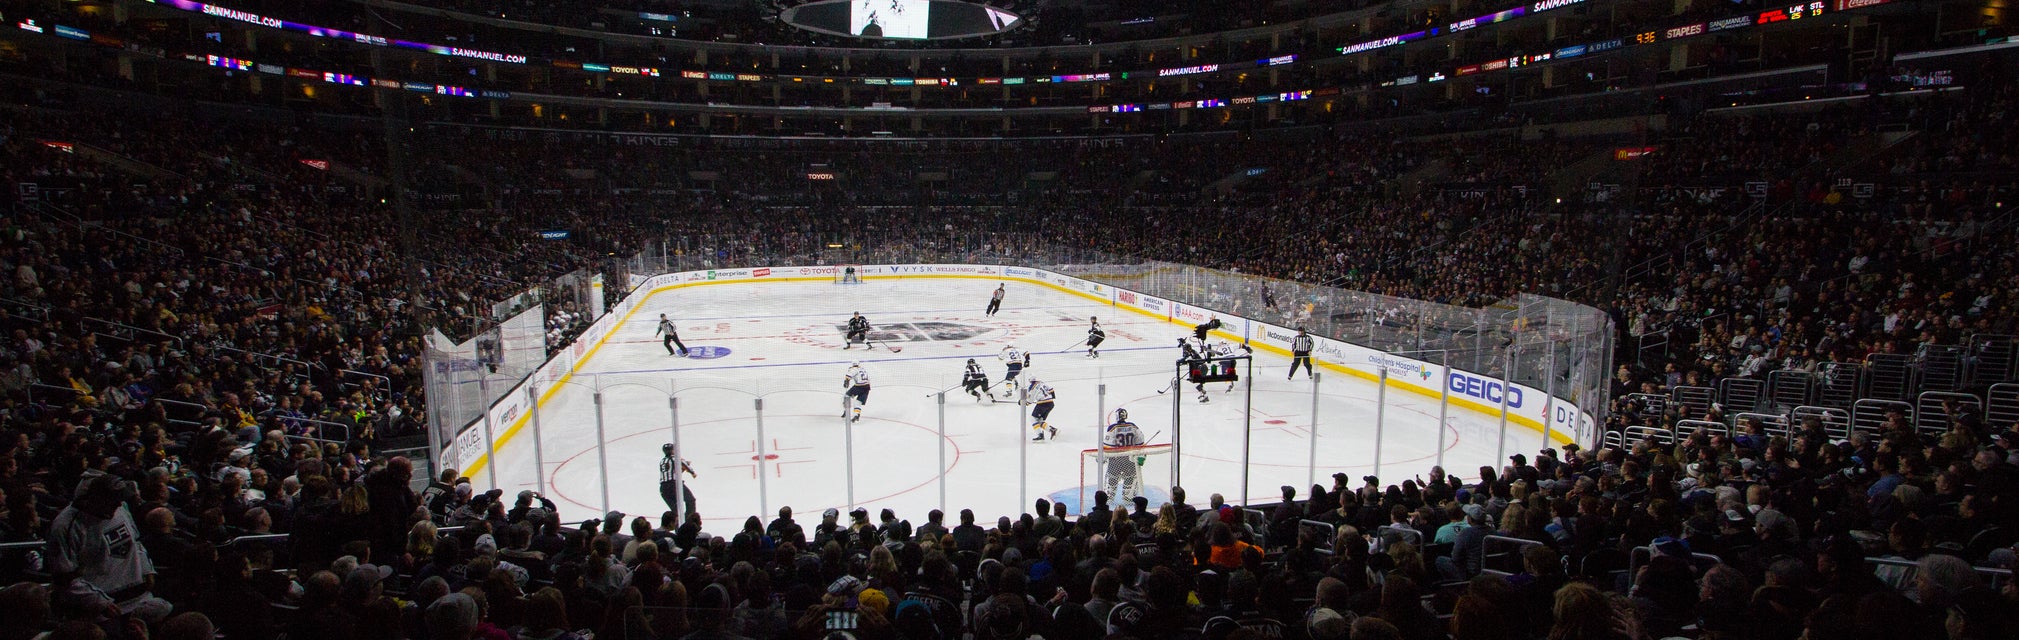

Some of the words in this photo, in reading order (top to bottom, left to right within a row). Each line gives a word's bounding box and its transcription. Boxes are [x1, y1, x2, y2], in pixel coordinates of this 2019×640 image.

[1789, 5, 1804, 14] LAK
[1810, 2, 1825, 11] STL
[202, 4, 283, 29] SANMANUEL.COM
[1812, 9, 1822, 17] 19
[1666, 24, 1703, 39] STAPLES
[1342, 36, 1399, 55] SANMANUEL.COM
[1596, 40, 1623, 51] DELTA
[451, 47, 527, 64] SANMANUEL.COM
[611, 66, 639, 74] TOYOTA
[1159, 64, 1218, 77] SANMANUEL.COM
[1481, 60, 1508, 72] TOSHIBA
[372, 79, 401, 89] TOSHIBA
[488, 90, 510, 98] DELTA
[626, 136, 679, 147] KINGS
[812, 267, 840, 275] TOYOTA
[1144, 296, 1164, 306] AMERICAN
[1267, 331, 1293, 344] McDonald's
[1368, 355, 1395, 367] Children's
[1396, 361, 1421, 373] Hospital
[1449, 372, 1523, 409] GEICO
[1115, 432, 1135, 447] 30
